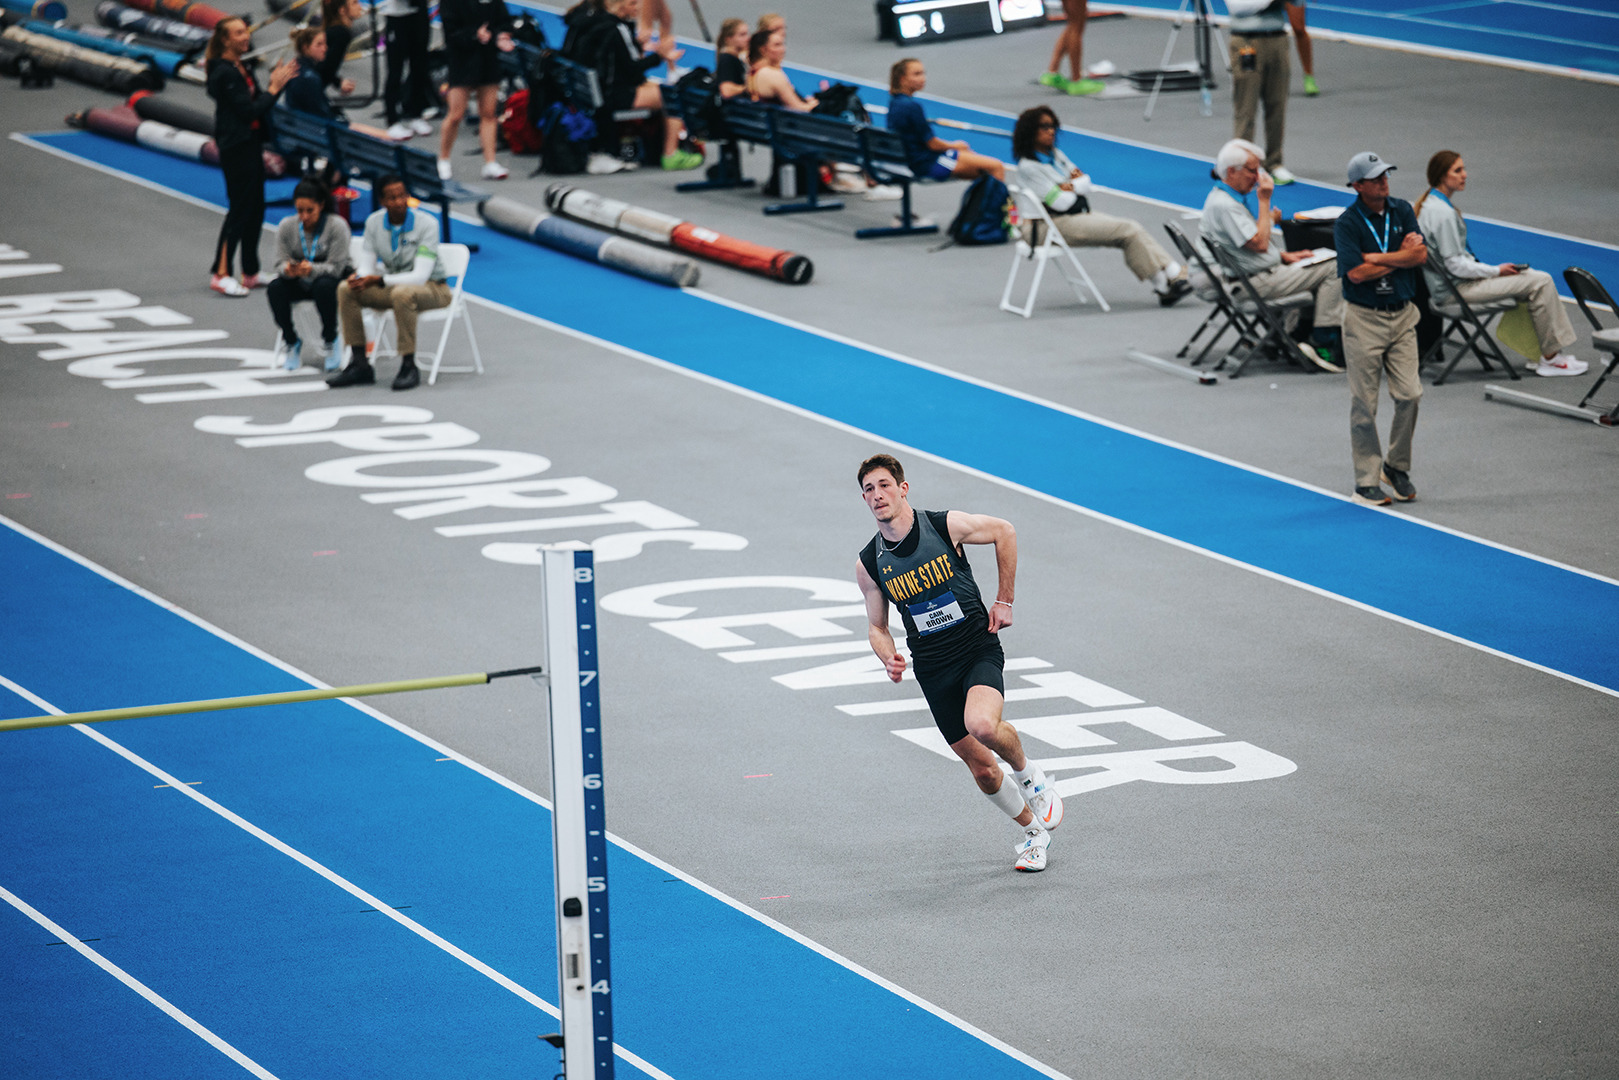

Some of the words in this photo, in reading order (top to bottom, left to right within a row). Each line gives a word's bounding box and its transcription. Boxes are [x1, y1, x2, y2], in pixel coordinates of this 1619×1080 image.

[194, 404, 749, 565] SPORTS
[574, 567, 594, 583] 8
[885, 569, 924, 602] WAYNE
[918, 553, 954, 590] STATE
[925, 613, 954, 628] BROWN
[928, 609, 944, 619] CAIN
[578, 671, 597, 687] 7
[583, 774, 602, 790] 6
[587, 876, 606, 893] 5
[591, 979, 611, 995] 4
